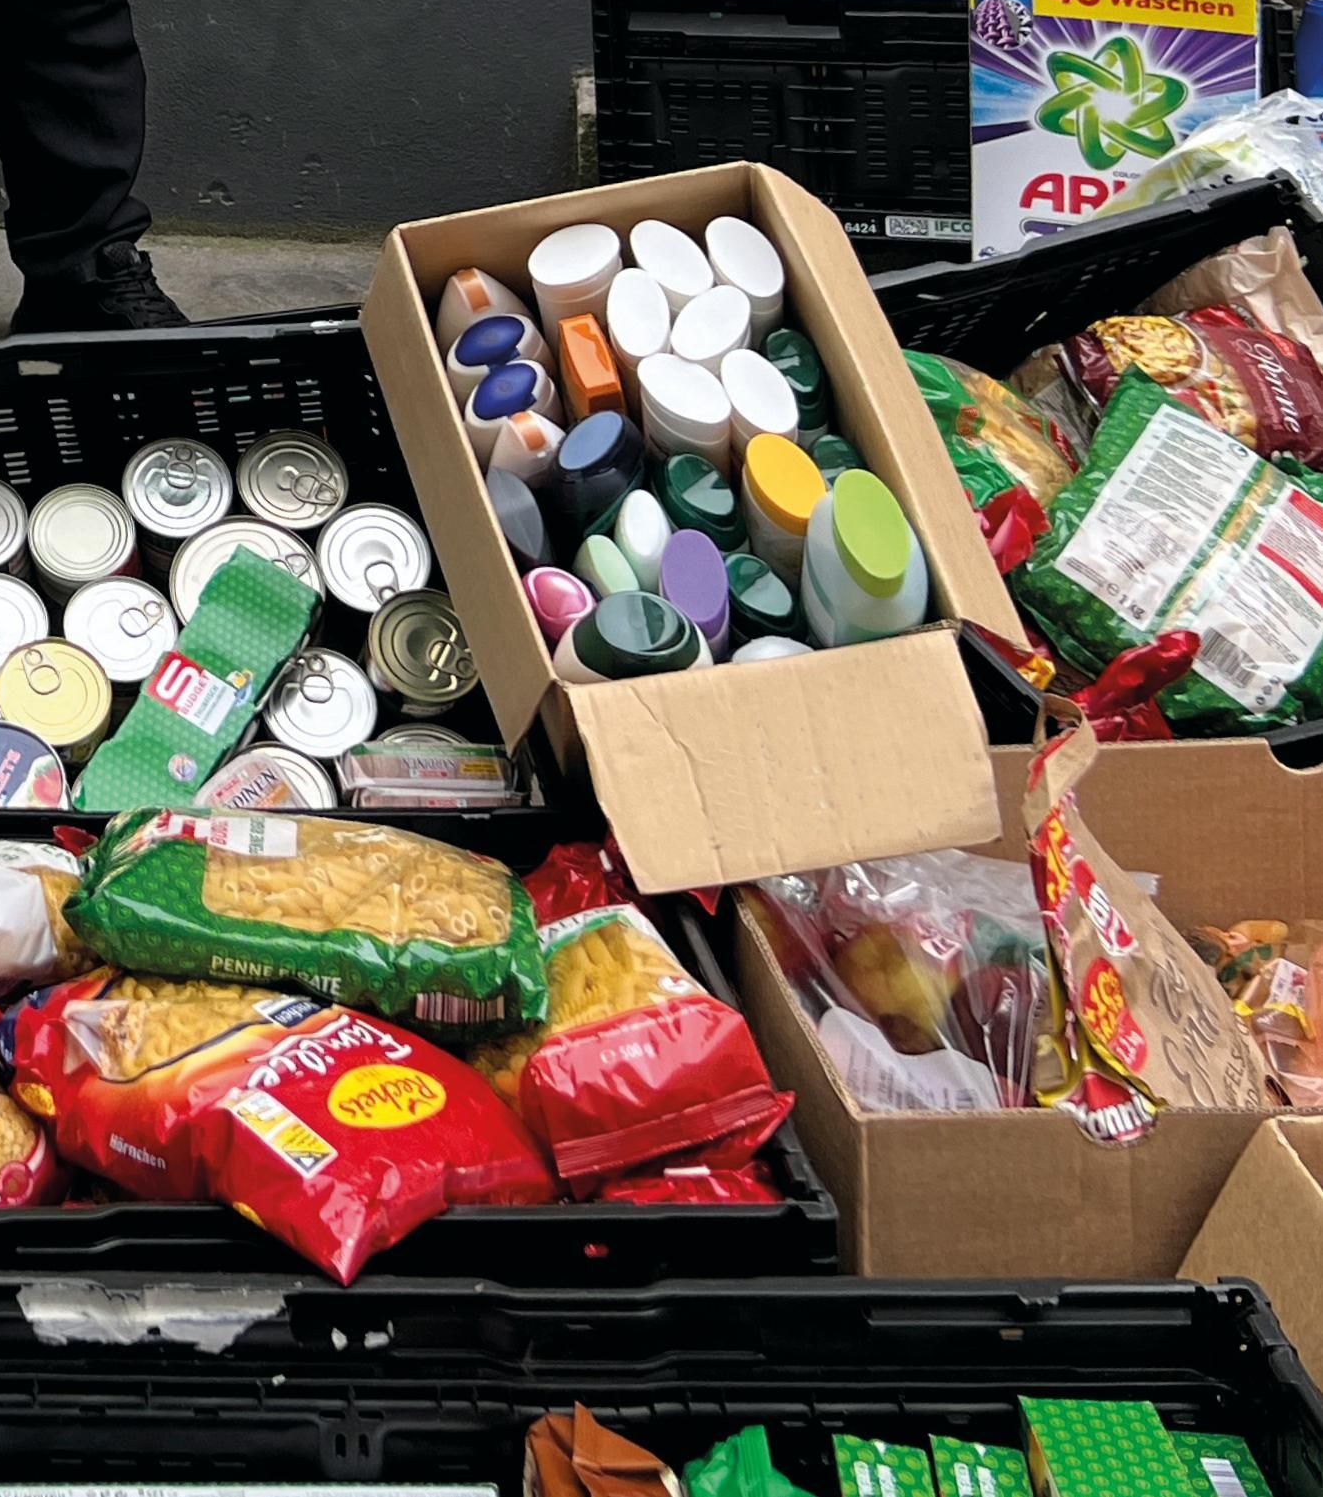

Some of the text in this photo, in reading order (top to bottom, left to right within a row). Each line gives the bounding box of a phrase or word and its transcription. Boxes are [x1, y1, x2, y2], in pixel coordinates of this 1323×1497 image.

[1019, 173, 1126, 215] AR
[844, 221, 877, 234] 6424
[1257, 342, 1301, 434] Penne
[178, 670, 212, 715] BUDGET
[233, 766, 279, 808] DINEN
[211, 955, 272, 979] PENNE
[246, 1019, 413, 1090] Familie
[618, 1042, 644, 1060] 500
[337, 1073, 436, 1120] Recheis
[109, 1133, 167, 1171] Hörnchen
